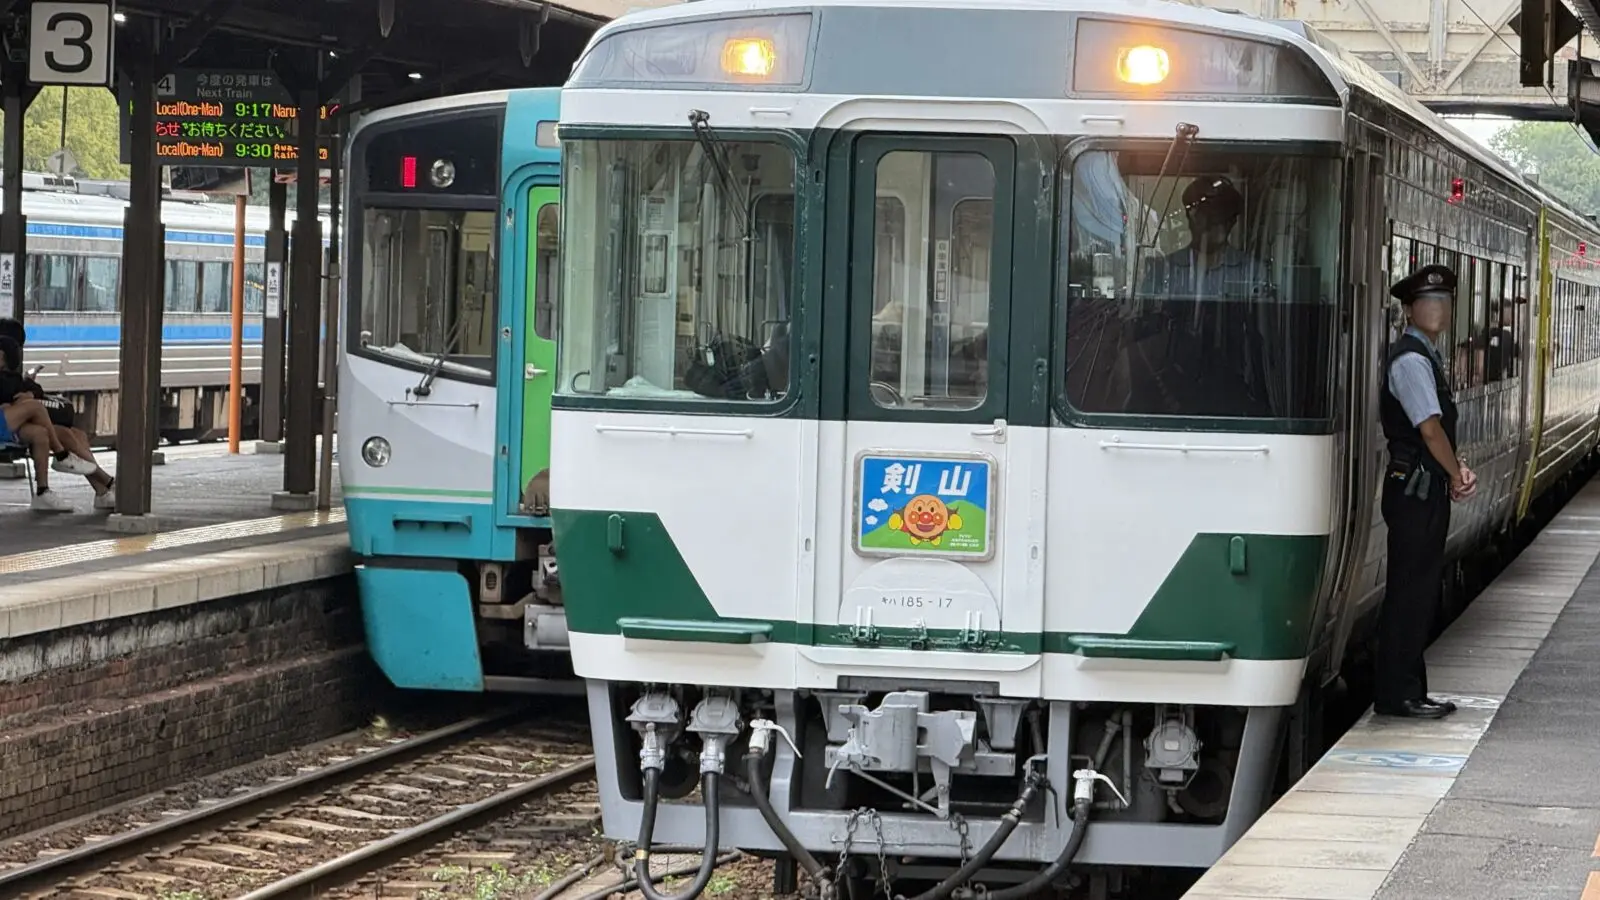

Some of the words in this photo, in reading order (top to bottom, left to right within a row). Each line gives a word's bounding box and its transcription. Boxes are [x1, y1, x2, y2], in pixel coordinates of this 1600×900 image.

[45, 12, 93, 73] 3
[157, 76, 171, 93] 4
[197, 74, 272, 87] 今度の発車は
[197, 87, 221, 98] Next
[226, 87, 252, 99] Train
[156, 101, 223, 116] Local(One-Man)
[235, 102, 271, 117] 9:17
[273, 104, 300, 117] Naru
[156, 142, 224, 157] Local(One-Man)
[235, 144, 272, 157] 9:30
[880, 463, 972, 495] 剣山
